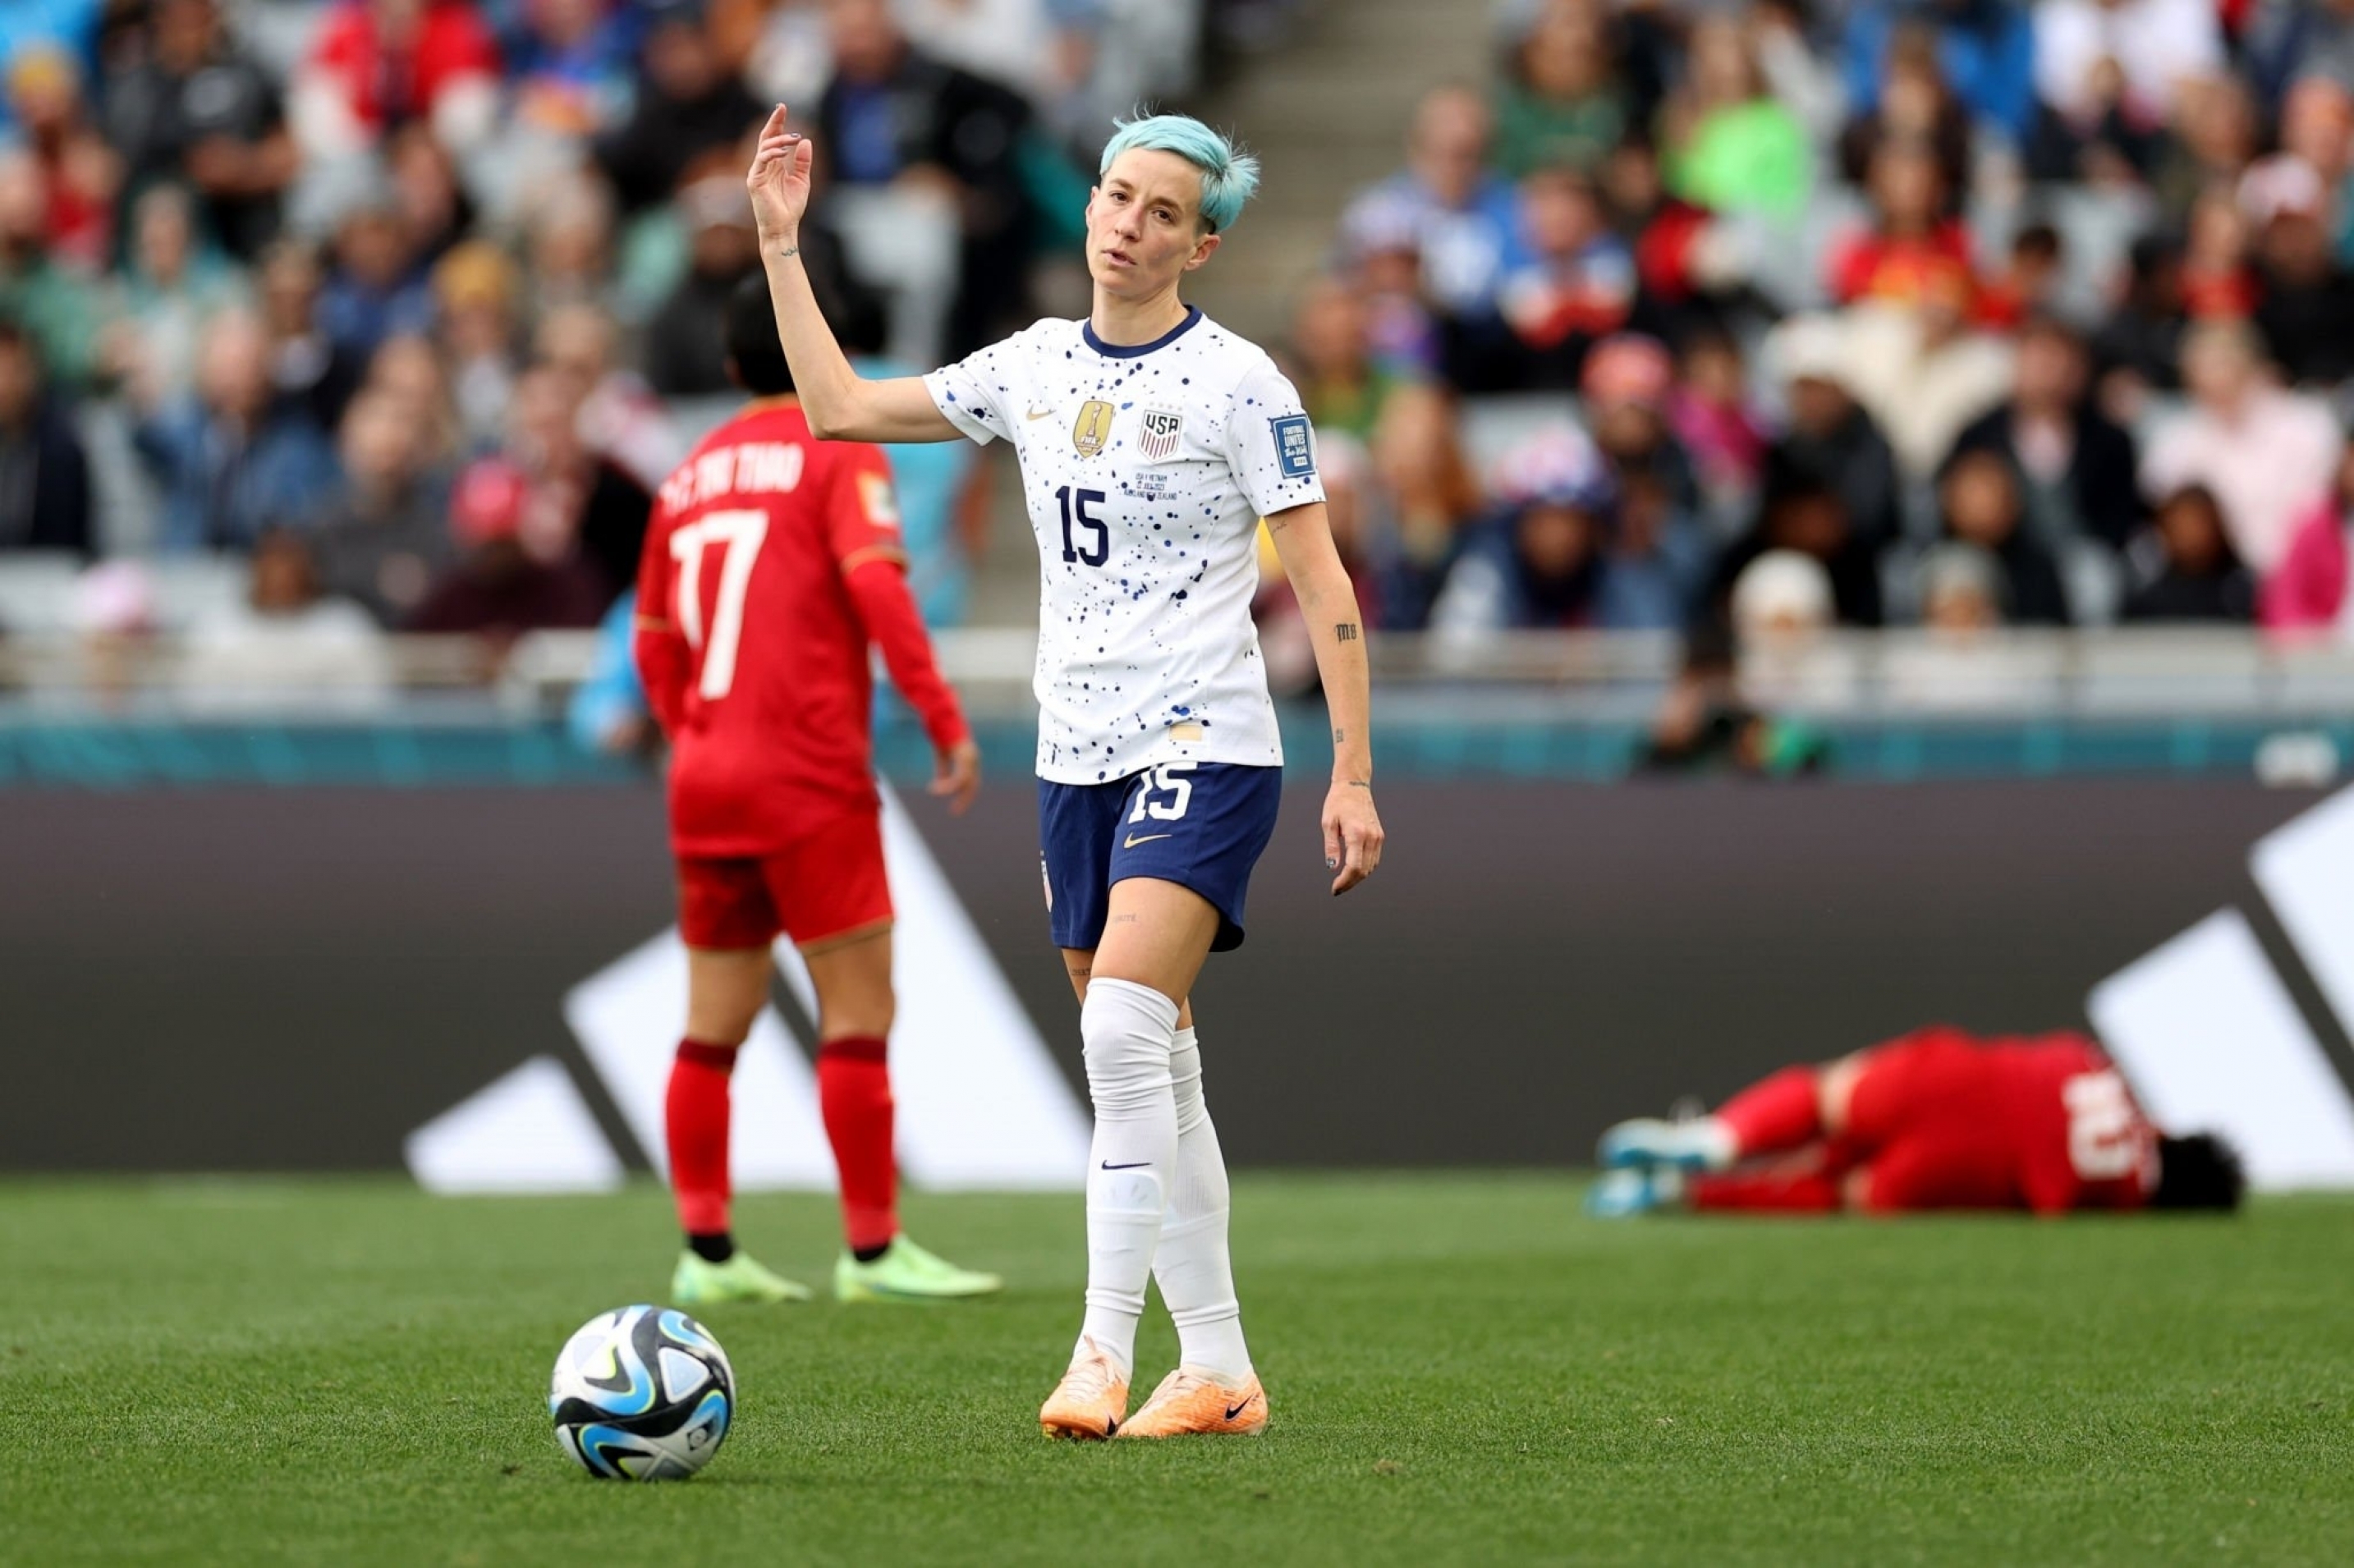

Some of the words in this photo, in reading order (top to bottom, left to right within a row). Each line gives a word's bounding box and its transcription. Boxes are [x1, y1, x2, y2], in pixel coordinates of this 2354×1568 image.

[1146, 414, 1179, 435] USA
[1284, 433, 1305, 447] UNITES
[1055, 485, 1109, 568] 15
[669, 509, 769, 701] 17
[1127, 761, 1198, 825] 15
